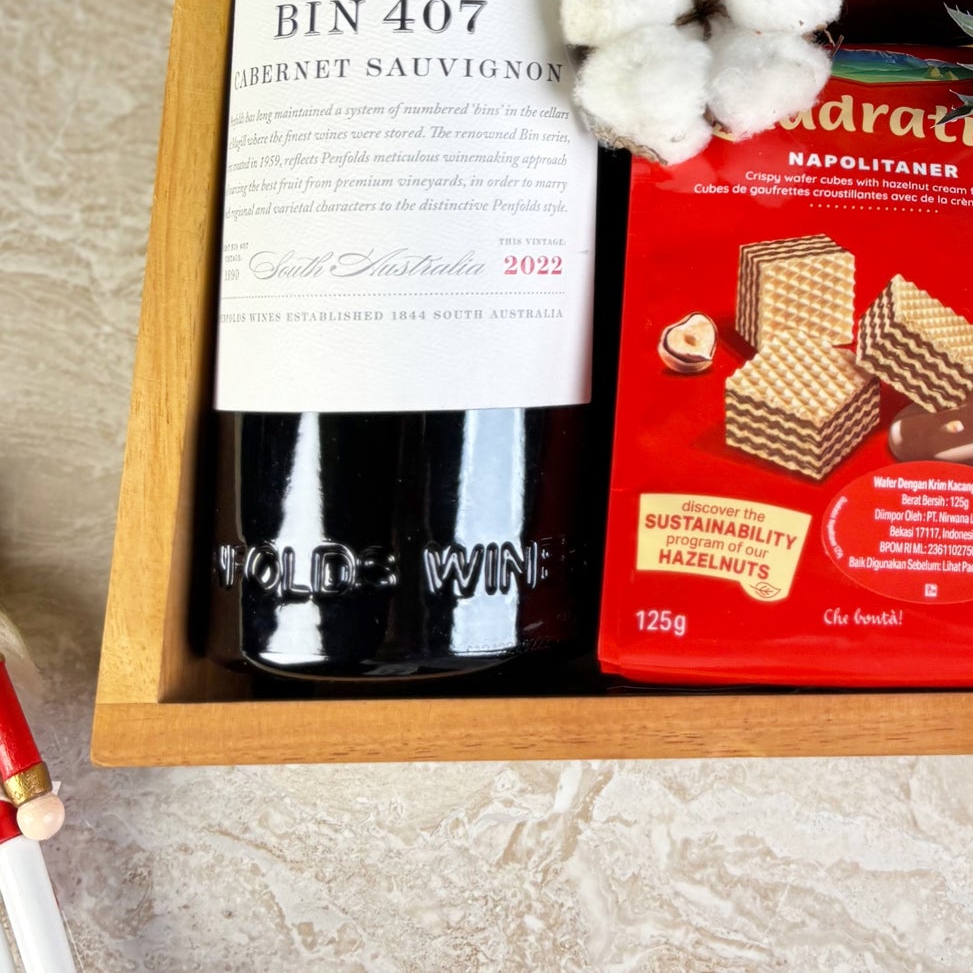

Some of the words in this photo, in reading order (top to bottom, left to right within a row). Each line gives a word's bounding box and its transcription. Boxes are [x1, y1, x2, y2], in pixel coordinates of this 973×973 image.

[234, 58, 352, 91] CABERNET
[365, 56, 563, 85] SAUVIGNON
[273, 103, 332, 119] maintained
[344, 105, 385, 120] system
[403, 102, 469, 115] numbered
[539, 107, 570, 120] cellars
[313, 128, 348, 140] wines
[350, 129, 381, 139] were
[383, 126, 426, 139] stored.
[430, 125, 452, 139] The
[454, 128, 517, 140] renowned
[519, 128, 540, 141] Bin
[321, 150, 370, 167] Penfolds
[372, 150, 440, 163] meticulous
[443, 151, 519, 168] winemaking
[521, 154, 568, 169] approach
[788, 151, 959, 179] NAPOLITANER
[333, 175, 394, 192] premium
[397, 174, 467, 191] vineyards,
[486, 174, 519, 188] order
[535, 180, 568, 194] marry
[745, 170, 781, 184] Crispy
[784, 173, 818, 184] wafer
[820, 175, 853, 186] cubes
[856, 177, 879, 188] with
[882, 179, 929, 192] hazelnut
[932, 184, 967, 195] cream
[693, 183, 729, 195] Cubes
[732, 183, 747, 194] de
[750, 184, 810, 197] gaufrettes
[812, 188, 888, 201] croustillantes
[891, 193, 917, 203] avec
[920, 193, 934, 204] de
[315, 199, 377, 213] characters
[395, 198, 416, 211] the
[419, 198, 489, 211] distinctive
[491, 198, 541, 216] Penfolds
[248, 249, 335, 280] South
[329, 246, 486, 277] Australia
[503, 254, 563, 276] 2022
[286, 310, 384, 322] ESTABLISHED
[391, 310, 426, 320] 1844
[432, 309, 483, 320] SOUTH
[489, 308, 564, 320] AUSTRALIA
[873, 476, 897, 488] Wafer
[898, 477, 927, 492] Dengan
[928, 478, 947, 491] Krim
[681, 499, 741, 518] discover
[743, 506, 766, 523] the
[902, 494, 921, 505] Berat
[922, 495, 945, 507] Bersih
[950, 496, 969, 510] 125g
[875, 508, 904, 522] Diimpor
[905, 509, 922, 521] Oleh
[939, 512, 969, 524] Nirwana
[644, 513, 798, 551] SUSTAINABILITY
[890, 525, 914, 537] Bekasi
[665, 534, 725, 550] program
[728, 540, 743, 554] of
[745, 546, 769, 559] our
[880, 541, 903, 553] BPOM
[658, 548, 771, 580] HAZELNUTS
[867, 557, 906, 571] Digunakan
[942, 560, 961, 572] Lihat
[635, 609, 687, 636] 125g
[823, 608, 848, 625] Che
[853, 608, 903, 626] bontà!
